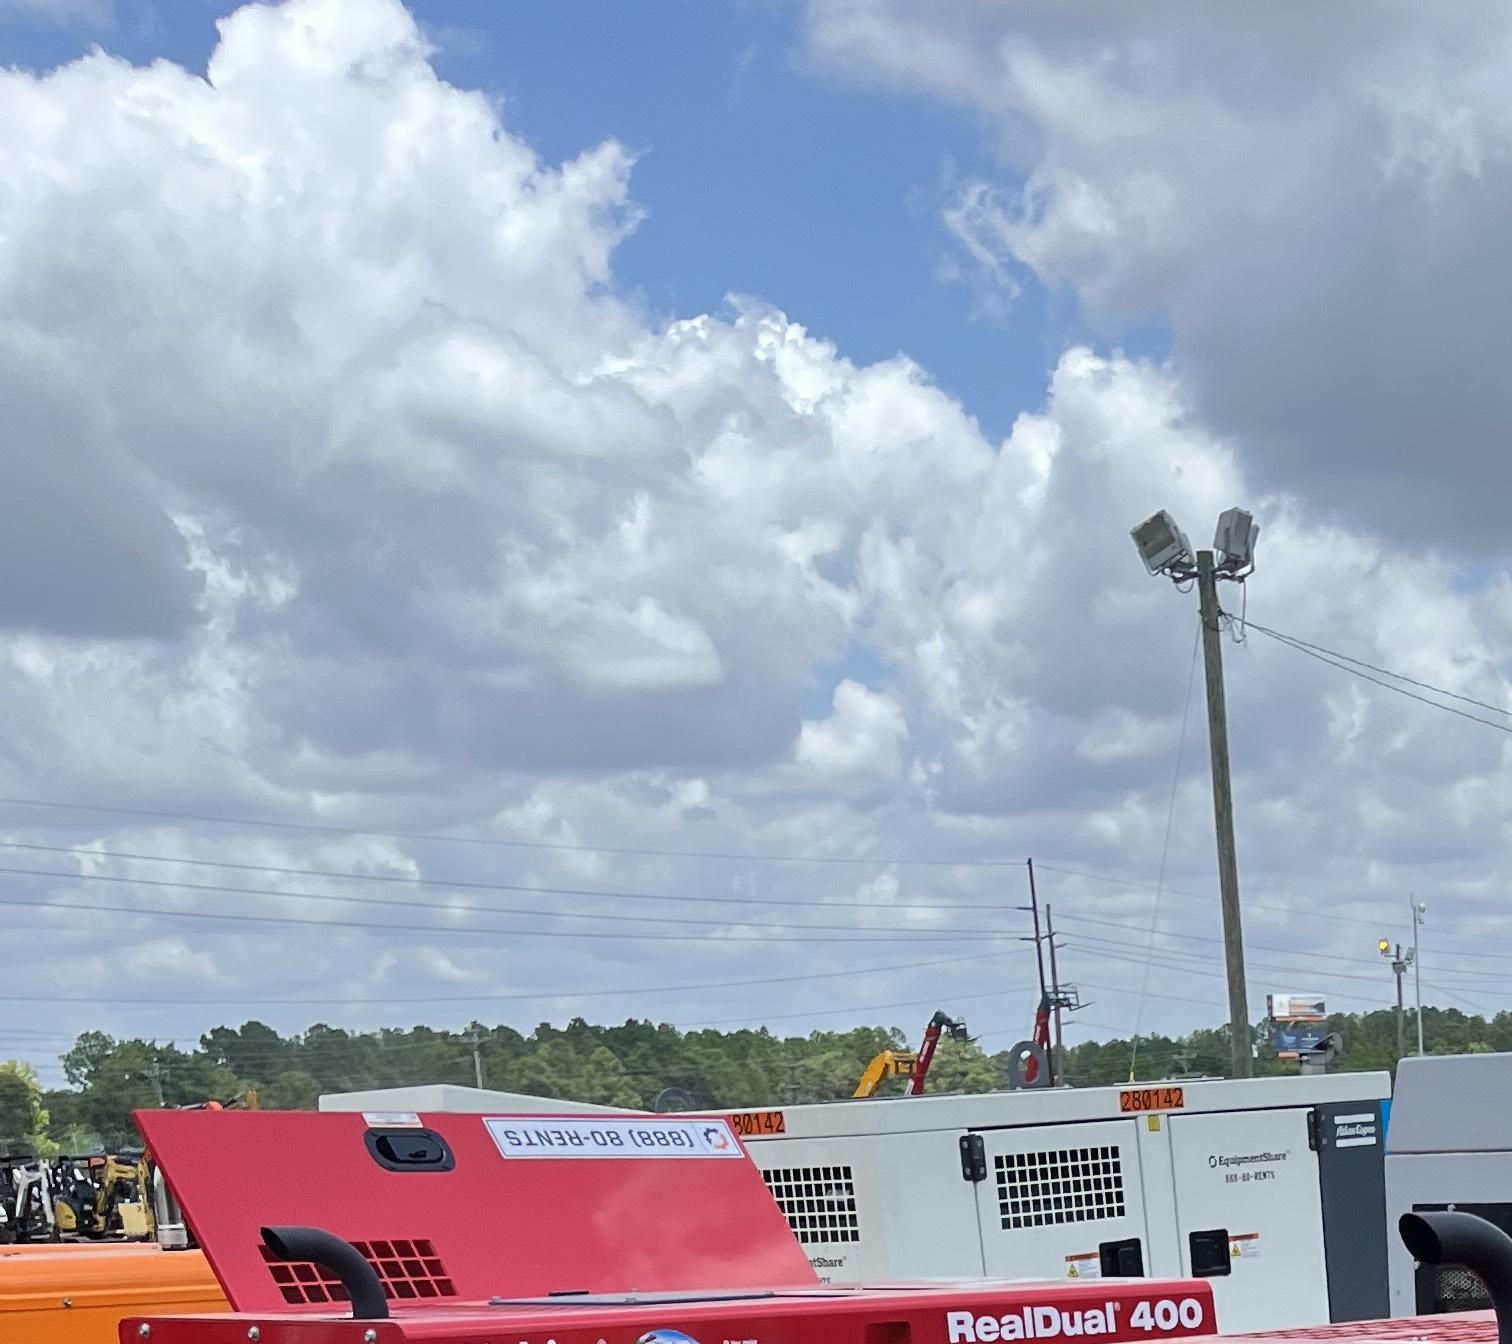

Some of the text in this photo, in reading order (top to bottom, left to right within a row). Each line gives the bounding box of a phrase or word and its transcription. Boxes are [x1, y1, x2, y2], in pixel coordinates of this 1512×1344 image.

[1120, 1087, 1184, 1112] 280142
[504, 1129, 694, 1147] (888) 80-RENTS
[1218, 1152, 1287, 1167] EquipmentShare
[947, 1298, 1203, 1344] RealDual 400
